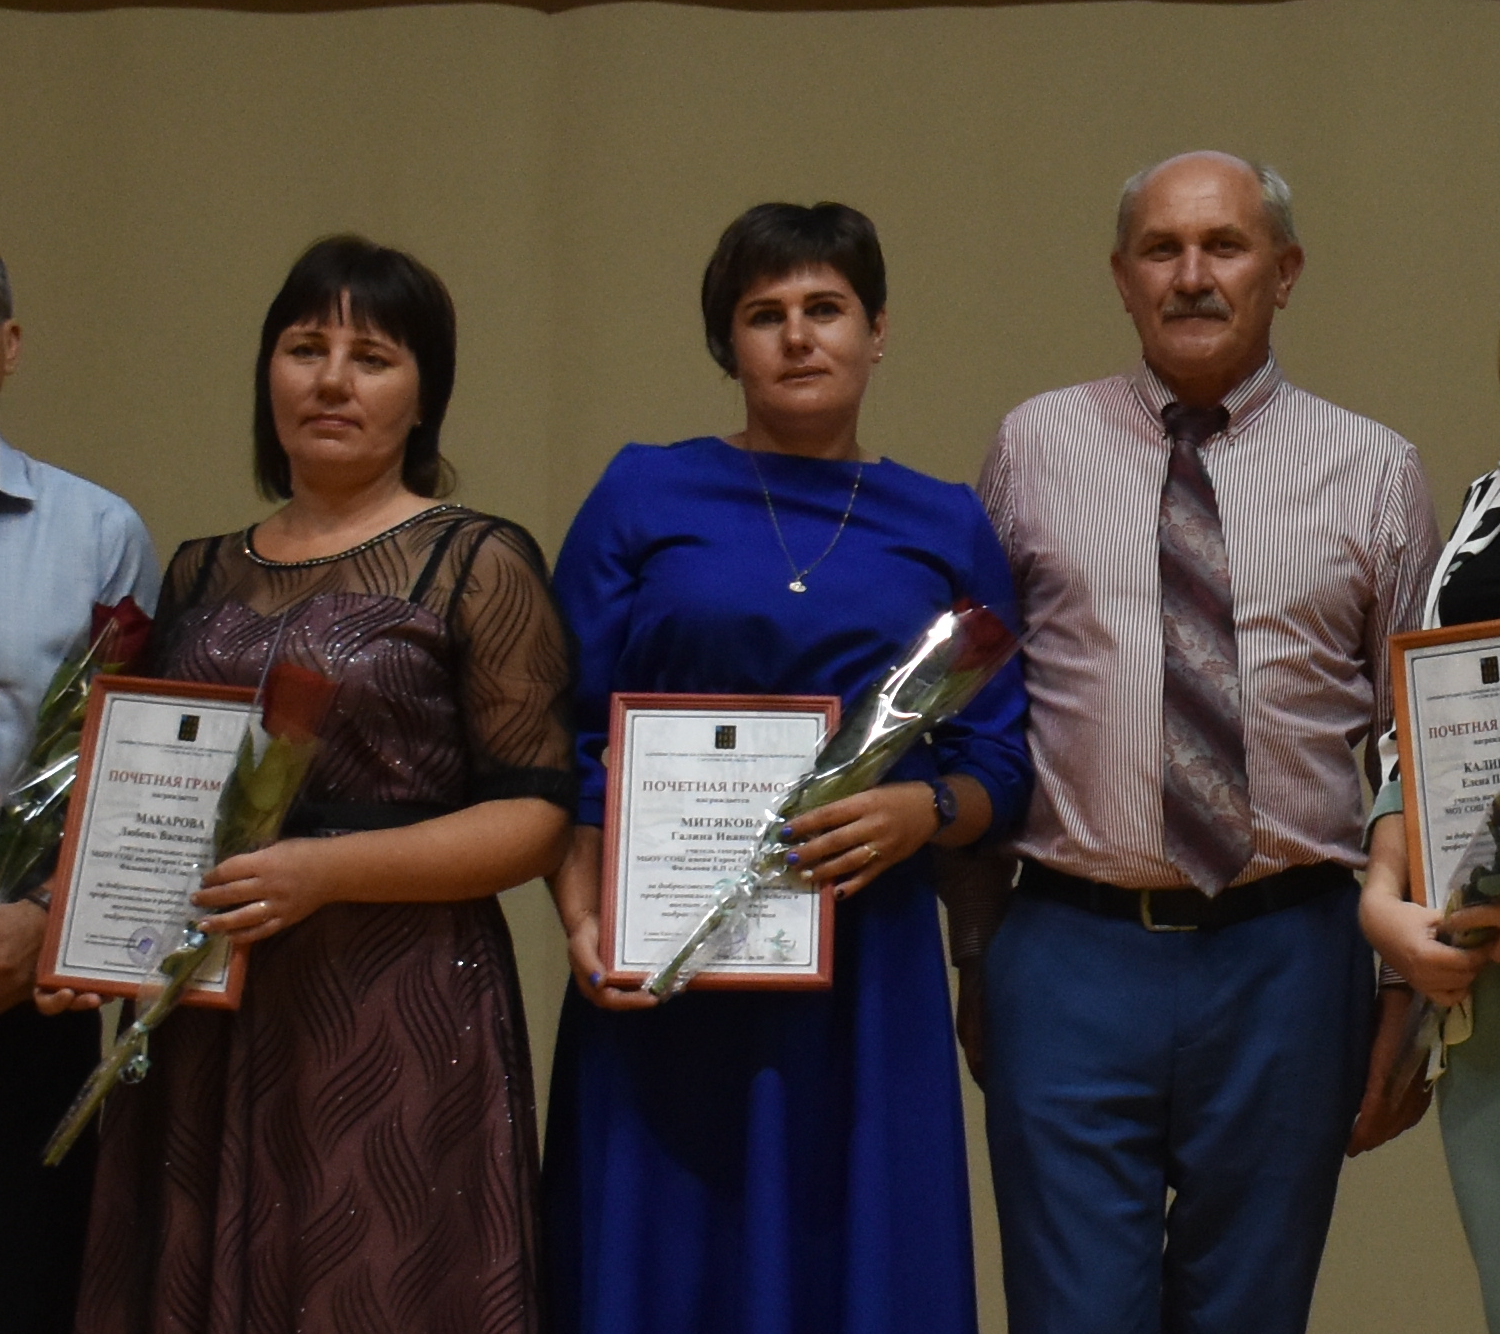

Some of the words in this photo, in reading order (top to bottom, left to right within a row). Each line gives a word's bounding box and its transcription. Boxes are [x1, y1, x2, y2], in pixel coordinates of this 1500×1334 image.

[1428, 717, 1498, 739] ПОЧЕТНАЯ
[108, 769, 183, 788] ПОЧЕТНАЯ
[642, 779, 727, 792] ПОЧЕТНАЯ
[1461, 774, 1490, 788] Елена
[134, 812, 207, 829] МАКАРОВА
[681, 817, 762, 827] МИТЯКОВА
[670, 831, 713, 840] Галина
